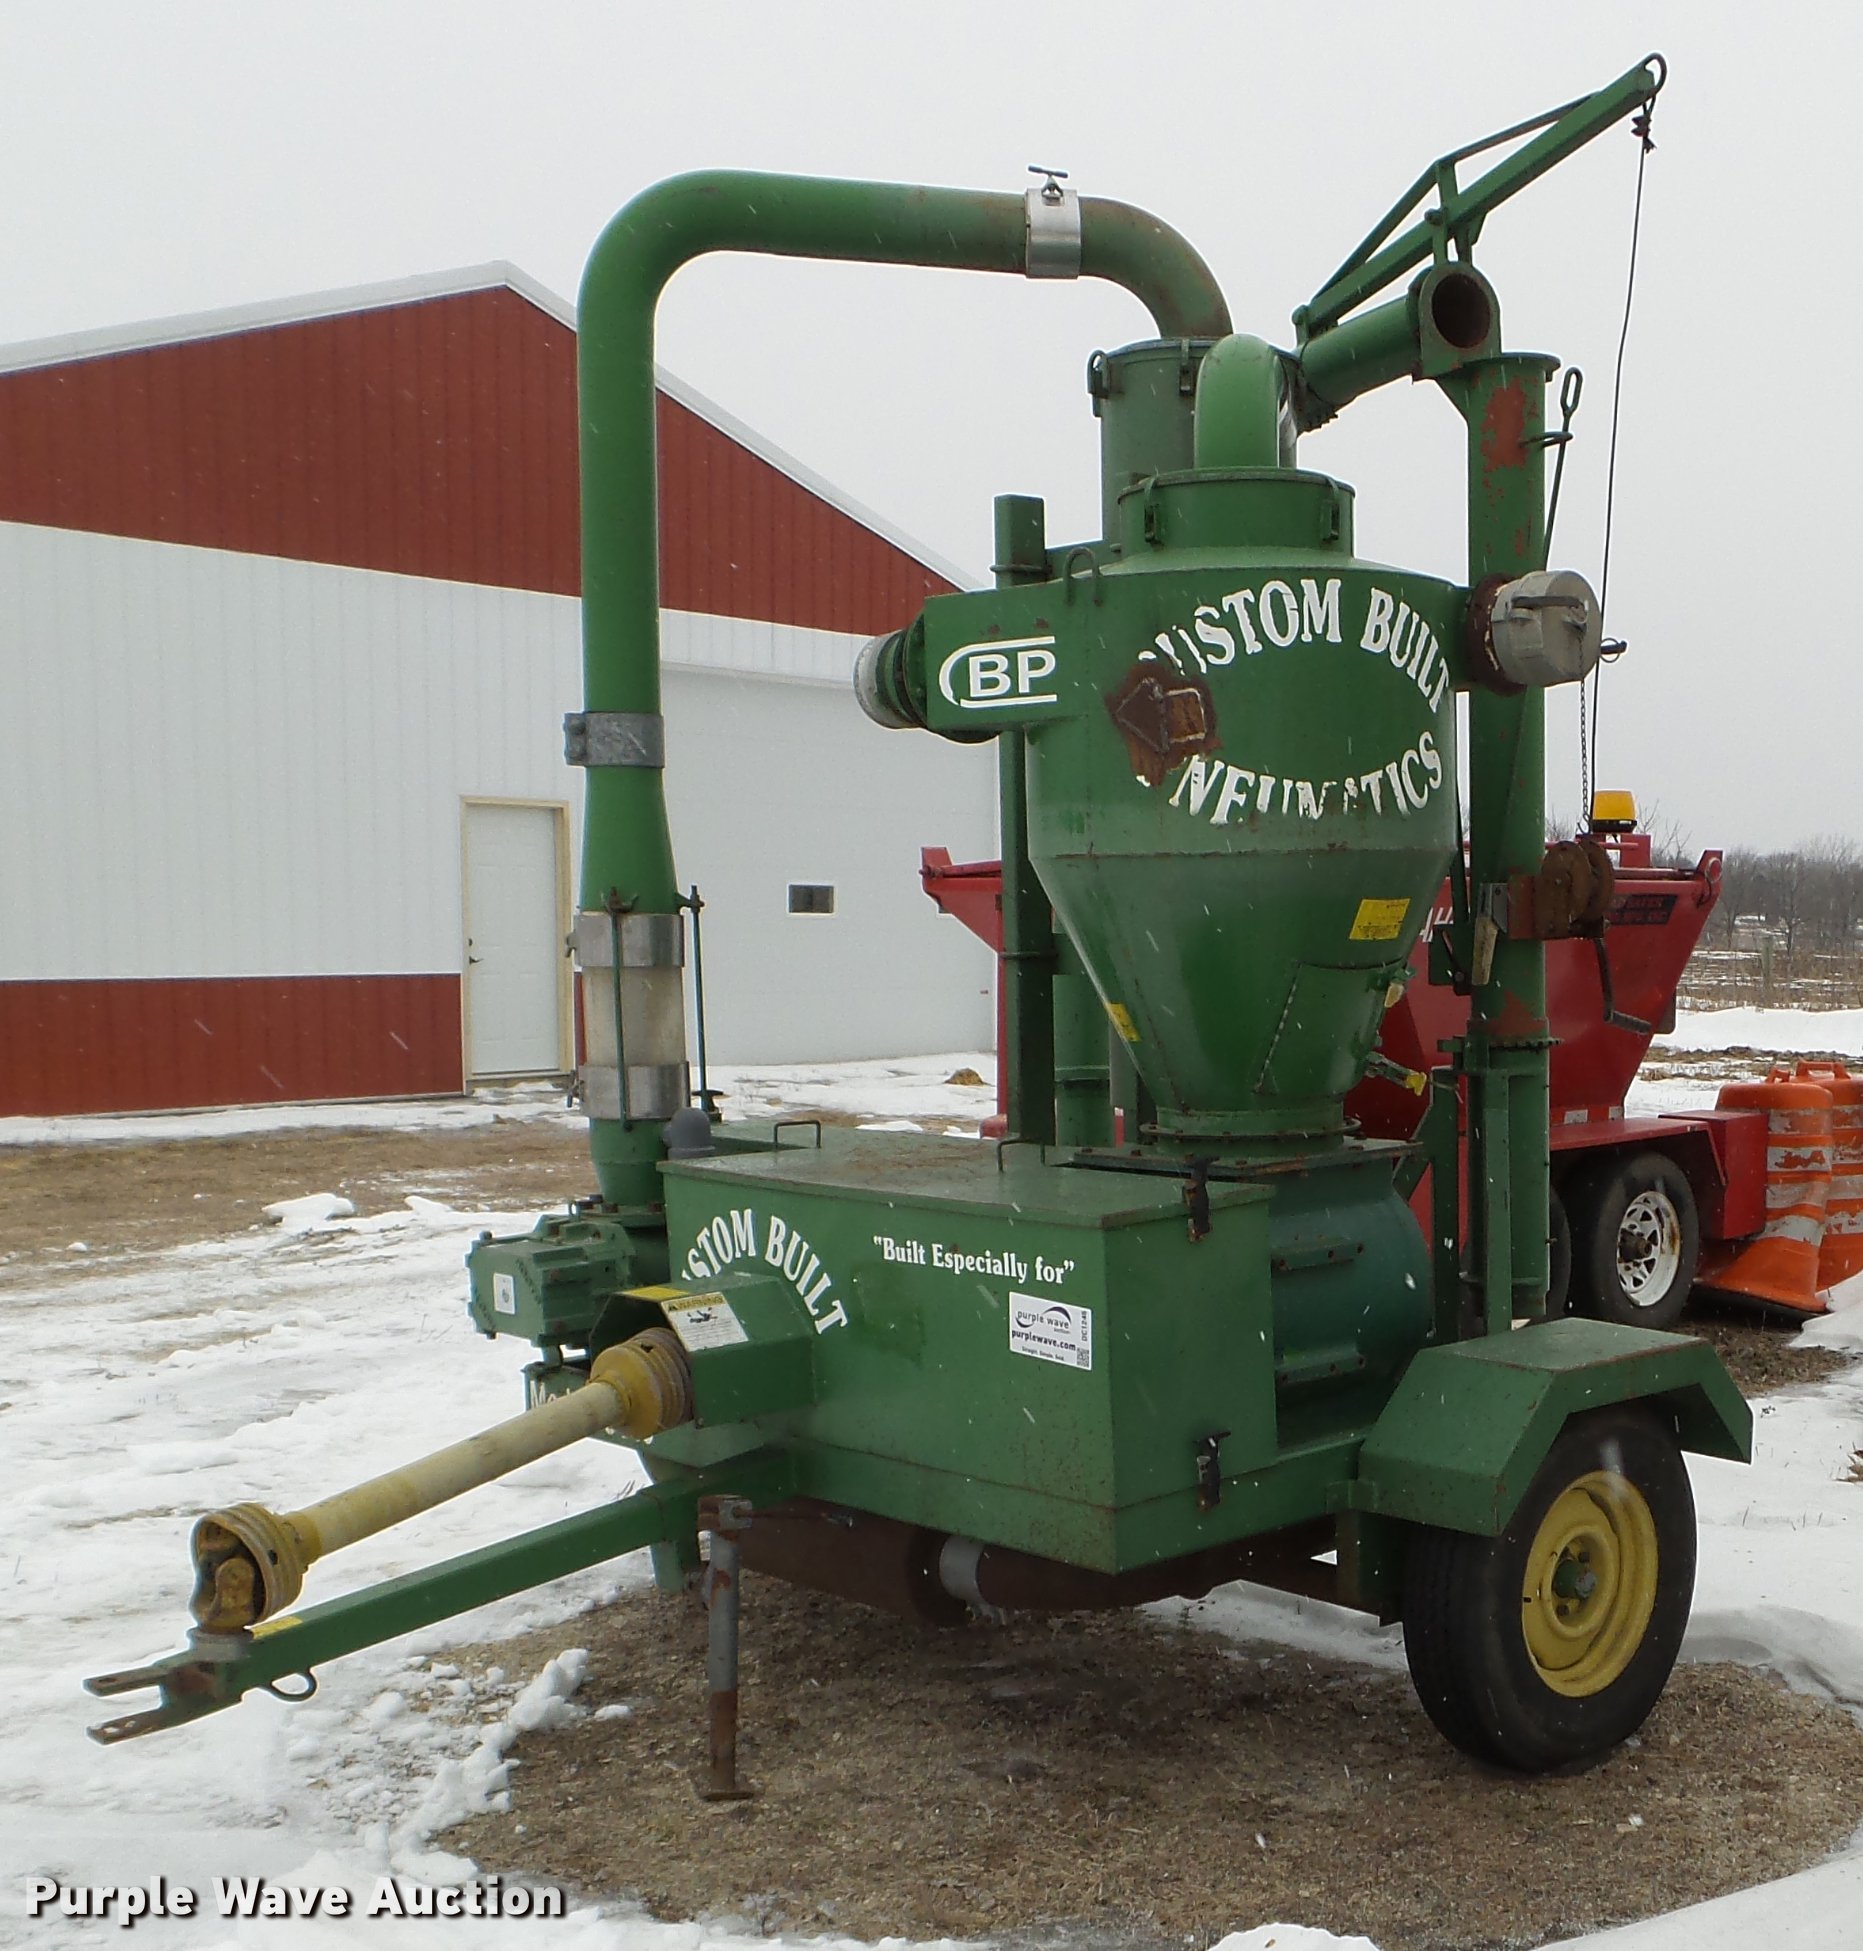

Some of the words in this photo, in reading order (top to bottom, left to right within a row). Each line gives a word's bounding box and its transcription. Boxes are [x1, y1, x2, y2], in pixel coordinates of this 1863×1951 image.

[1138, 578, 1342, 676] USTOM
[1360, 587, 1450, 713] BUILT
[1136, 731, 1443, 825] NEUMTICS
[765, 1215, 848, 1335] BUILT
[931, 1242, 1028, 1284] Especially
[1011, 1330, 1076, 1351] purplewave.com
[1017, 1309, 1044, 1324] purple
[1046, 1317, 1069, 1329] wave
